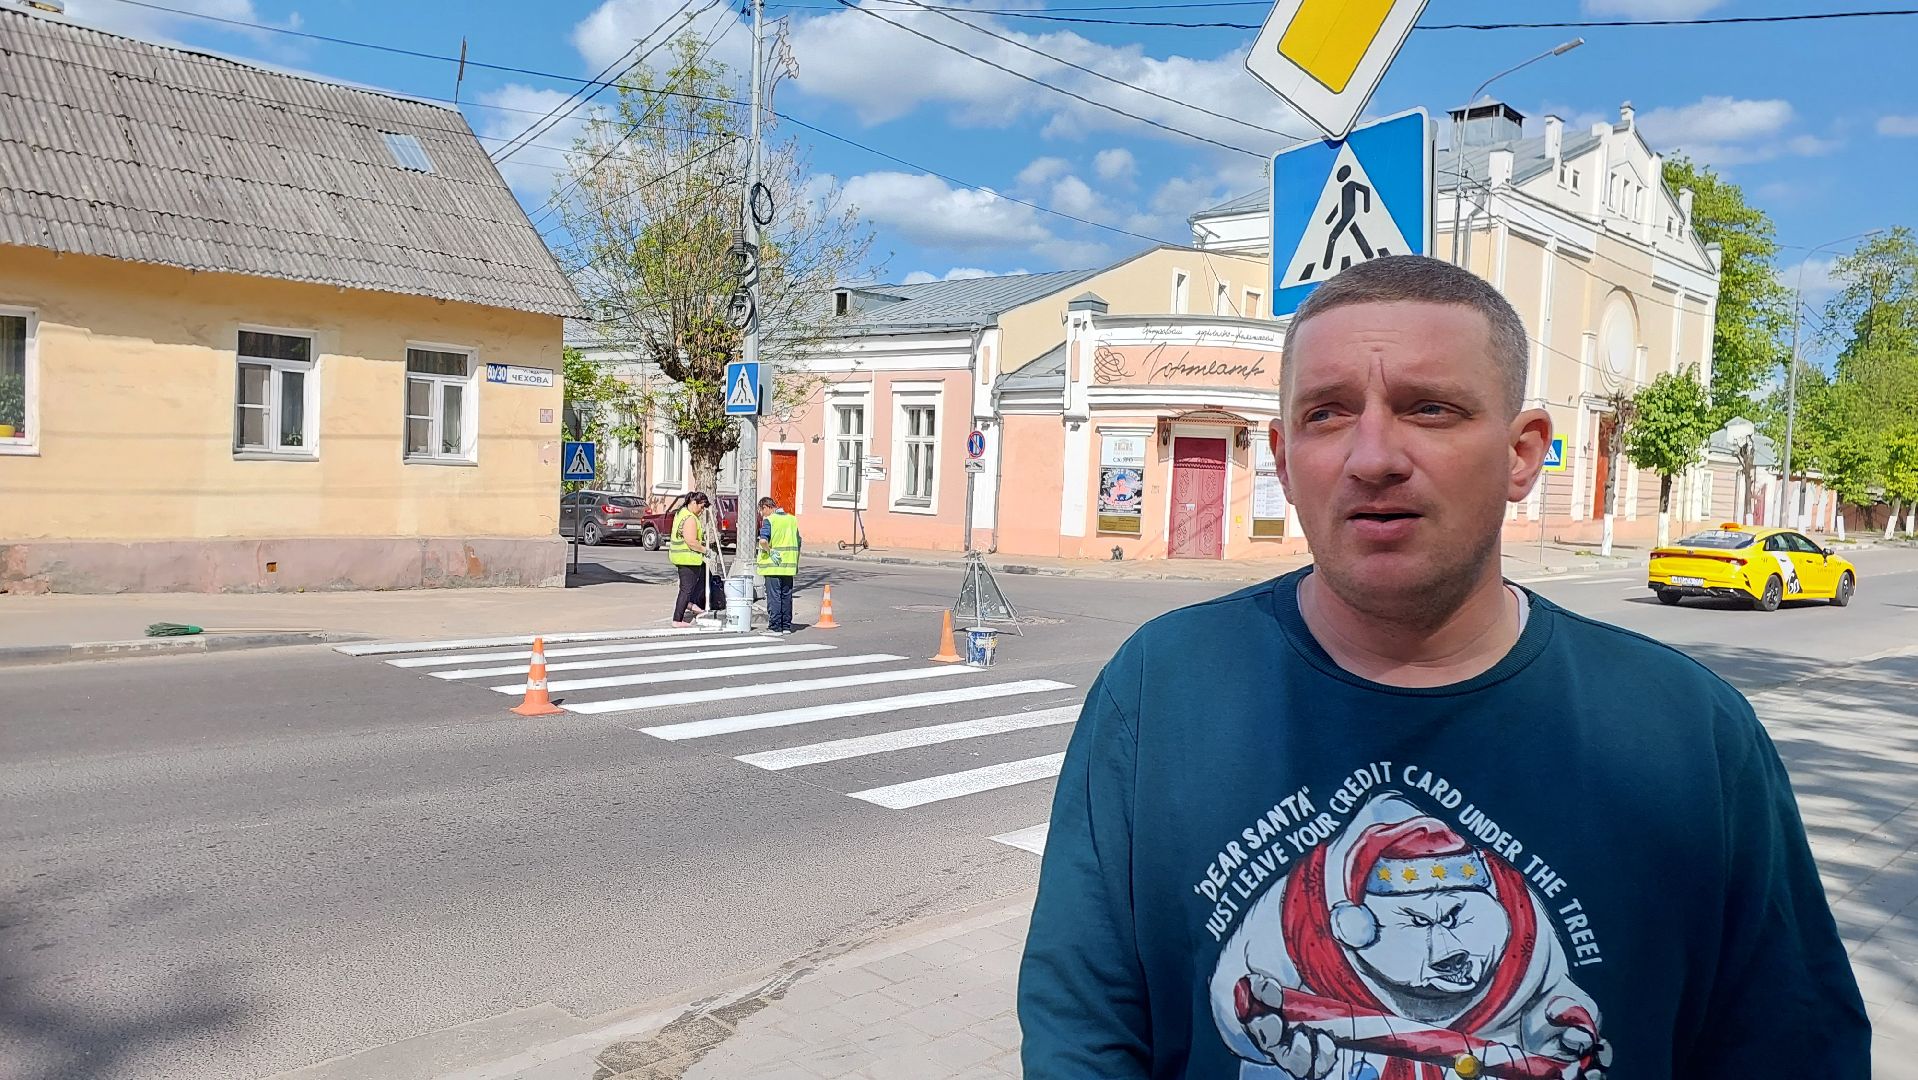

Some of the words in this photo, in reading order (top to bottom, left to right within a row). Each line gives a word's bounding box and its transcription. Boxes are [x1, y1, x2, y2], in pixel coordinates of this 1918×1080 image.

[512, 375, 549, 383] ЧЕХОВА
[1205, 891, 1239, 942] JUST
[1231, 842, 1290, 899] LEAVE
[1285, 812, 1341, 853] YOUR
[1329, 761, 1392, 814] CREDIT
[1403, 765, 1462, 809] CARD
[1458, 803, 1523, 862] UNDER
[1523, 854, 1567, 899] THE
[1558, 897, 1603, 968] TREE!
